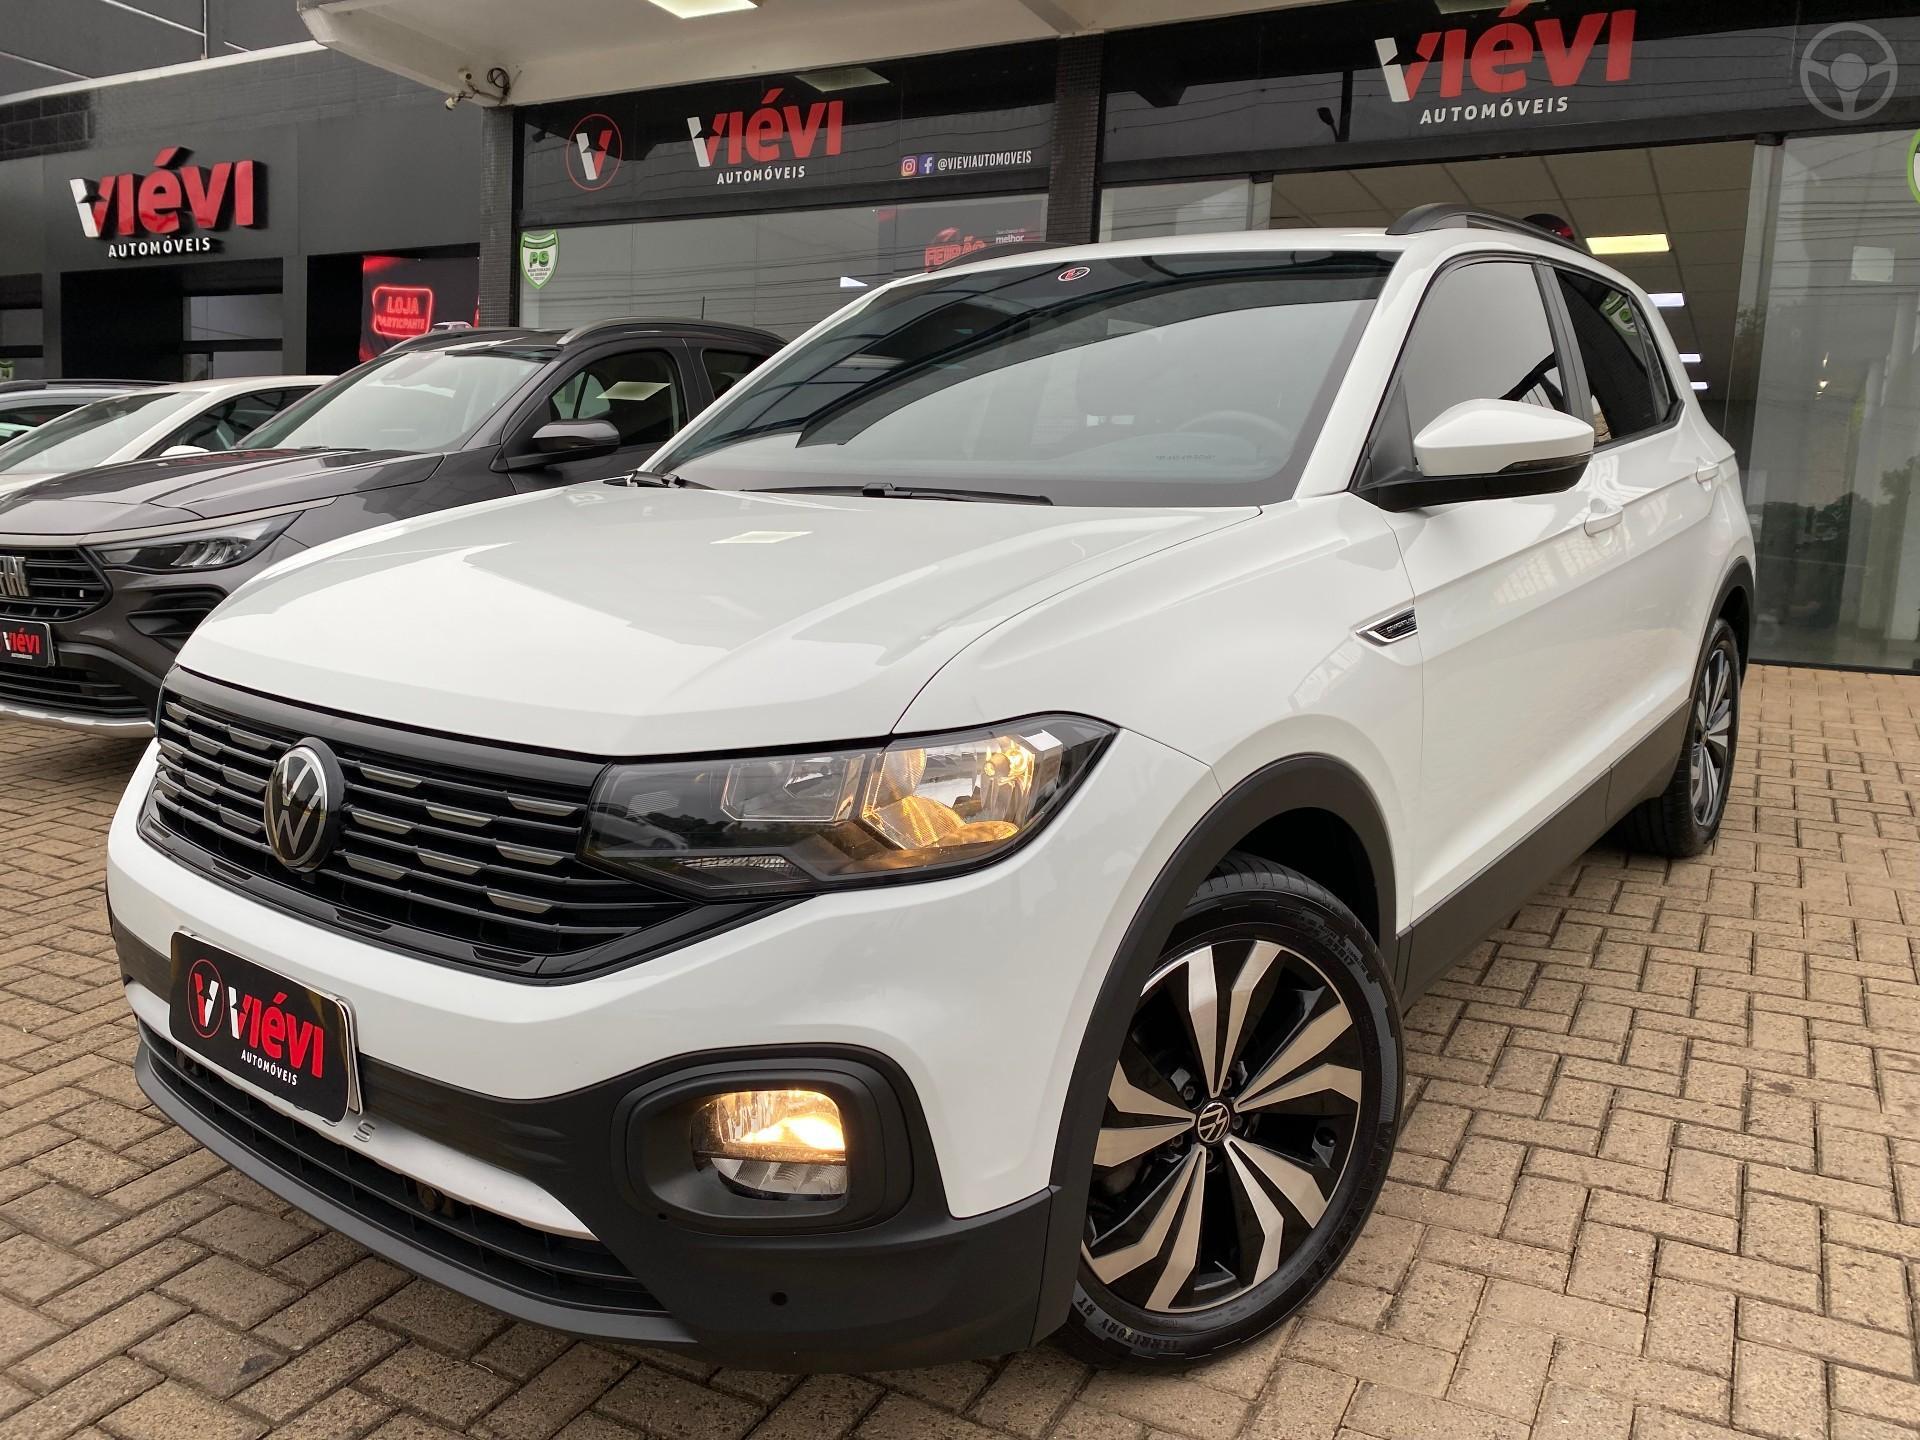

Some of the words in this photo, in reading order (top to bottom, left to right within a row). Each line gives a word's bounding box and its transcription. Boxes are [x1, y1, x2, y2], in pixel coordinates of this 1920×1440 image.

[1420, 97, 1569, 125] AUTOMÓVEIS
[937, 150, 1032, 171] @VIEVIAUTOMOVEIS
[717, 166, 806, 185] AUTOMÓVEIS
[108, 236, 211, 258] AUTOMÓVEIS
[995, 234, 1025, 244] melhor
[387, 296, 420, 315] LOJA
[240, 1048, 298, 1086] AUTOMÓVEIS
